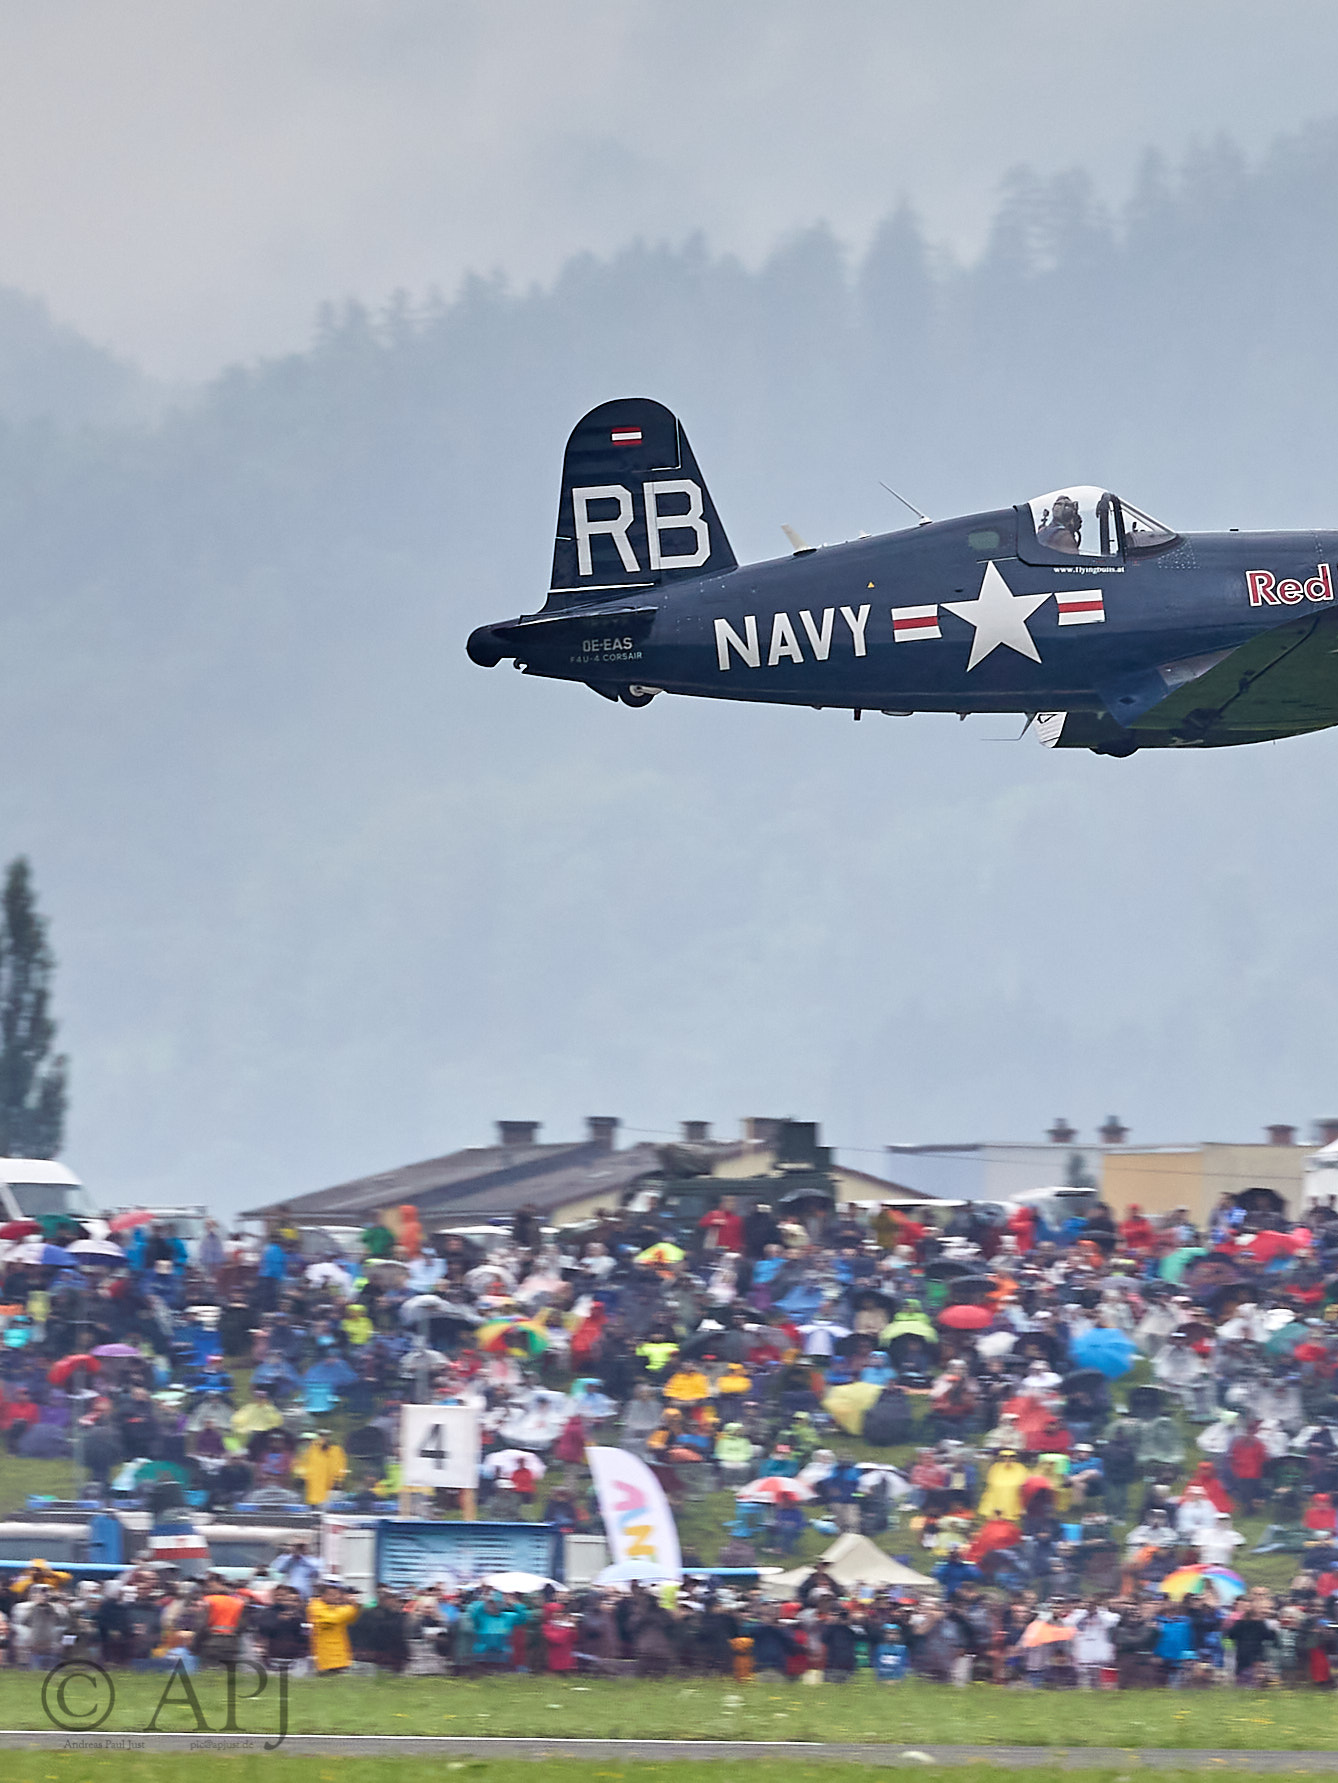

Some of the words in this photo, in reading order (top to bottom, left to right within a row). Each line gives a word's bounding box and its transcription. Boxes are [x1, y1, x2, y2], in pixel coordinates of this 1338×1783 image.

[572, 479, 711, 576] RB
[1246, 563, 1334, 607] Red
[582, 637, 633, 652] OE-EAS
[602, 652, 642, 661] CORSAIR
[714, 604, 871, 671] NAVY
[418, 1423, 448, 1470] 4
